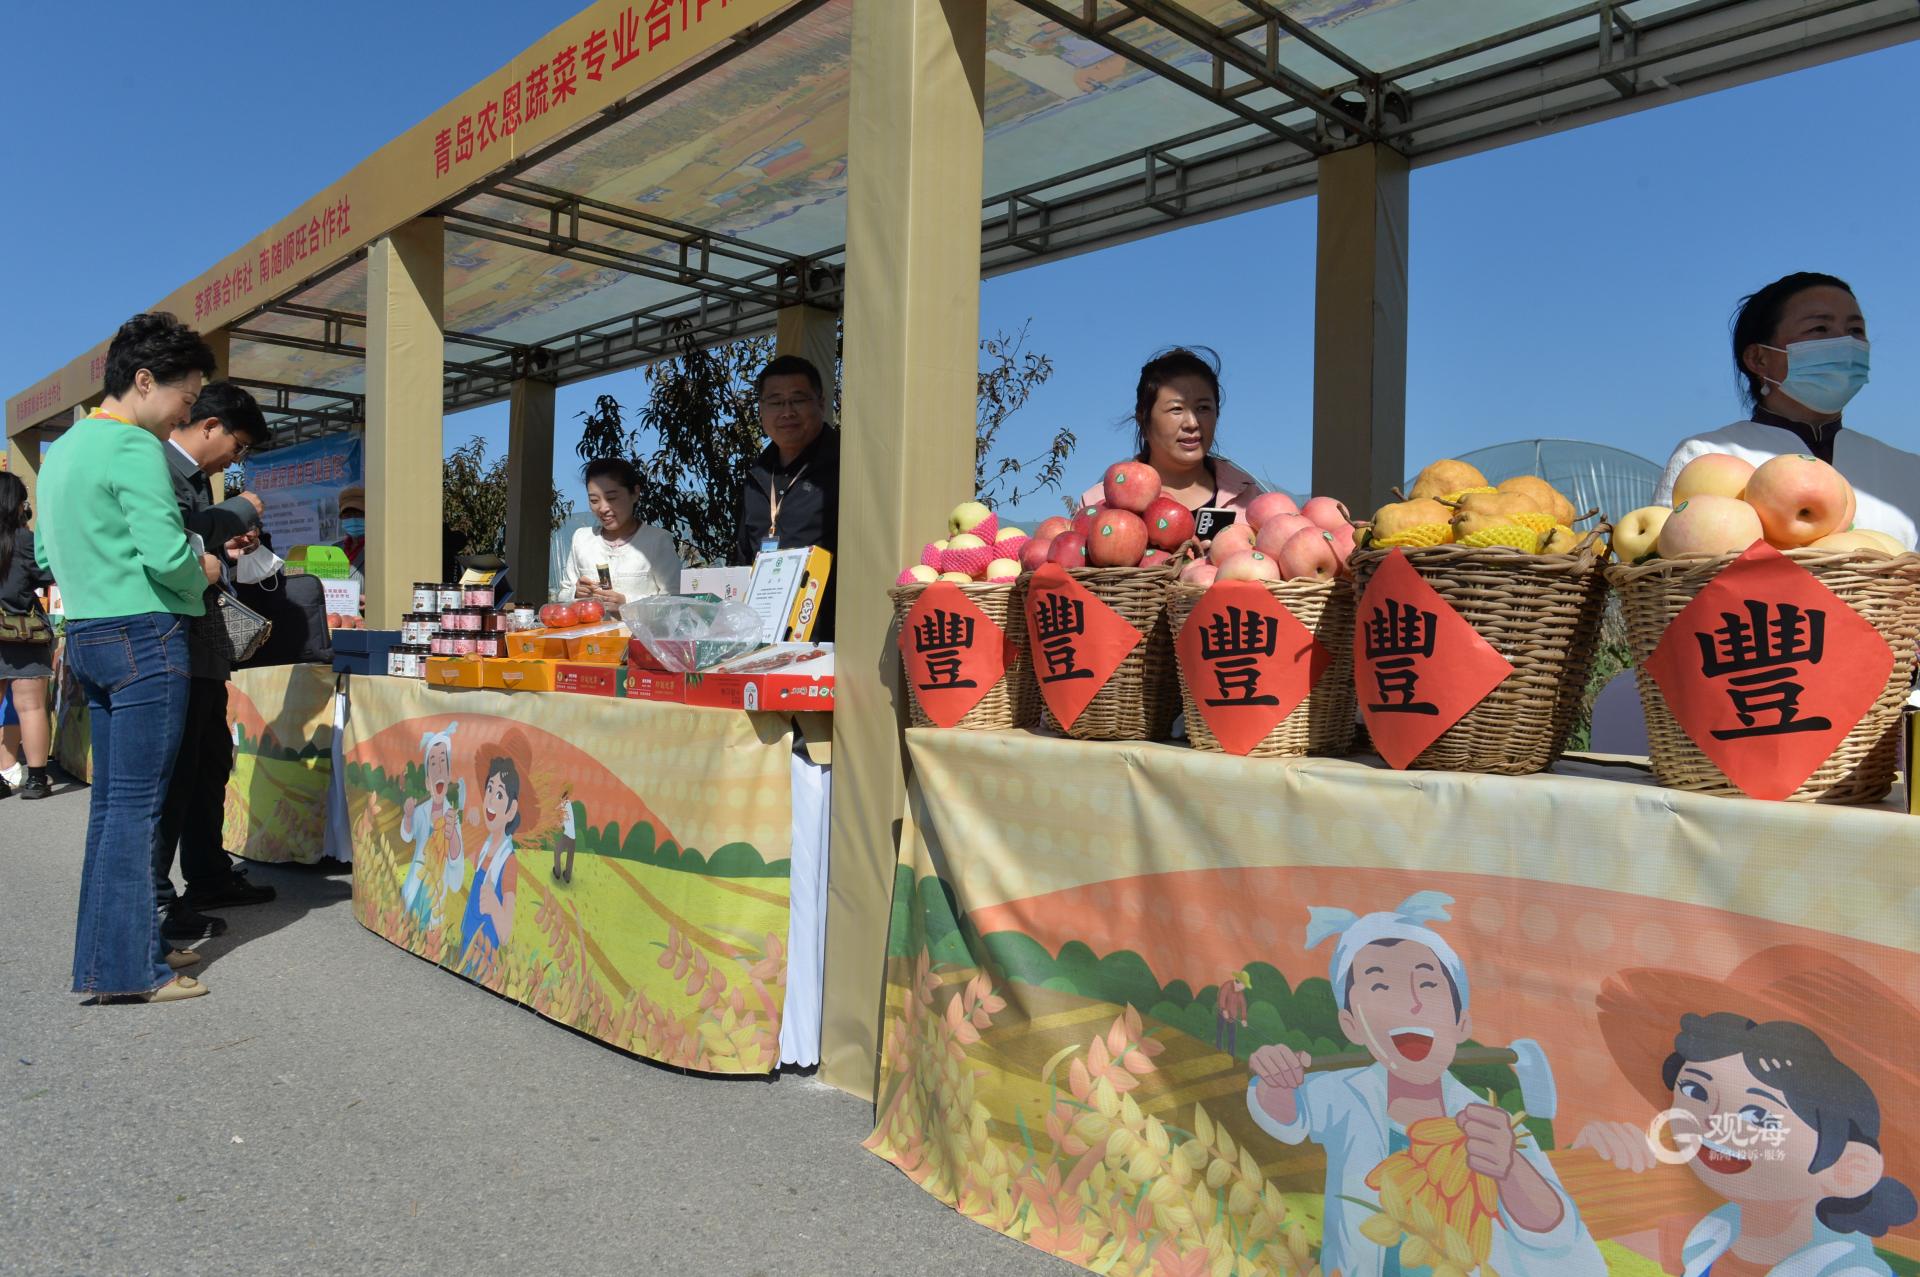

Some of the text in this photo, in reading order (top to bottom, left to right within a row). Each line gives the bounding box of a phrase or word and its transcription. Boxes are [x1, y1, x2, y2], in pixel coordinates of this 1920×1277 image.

[434, 0, 729, 179] 青岛农恩蔬菜专业合
